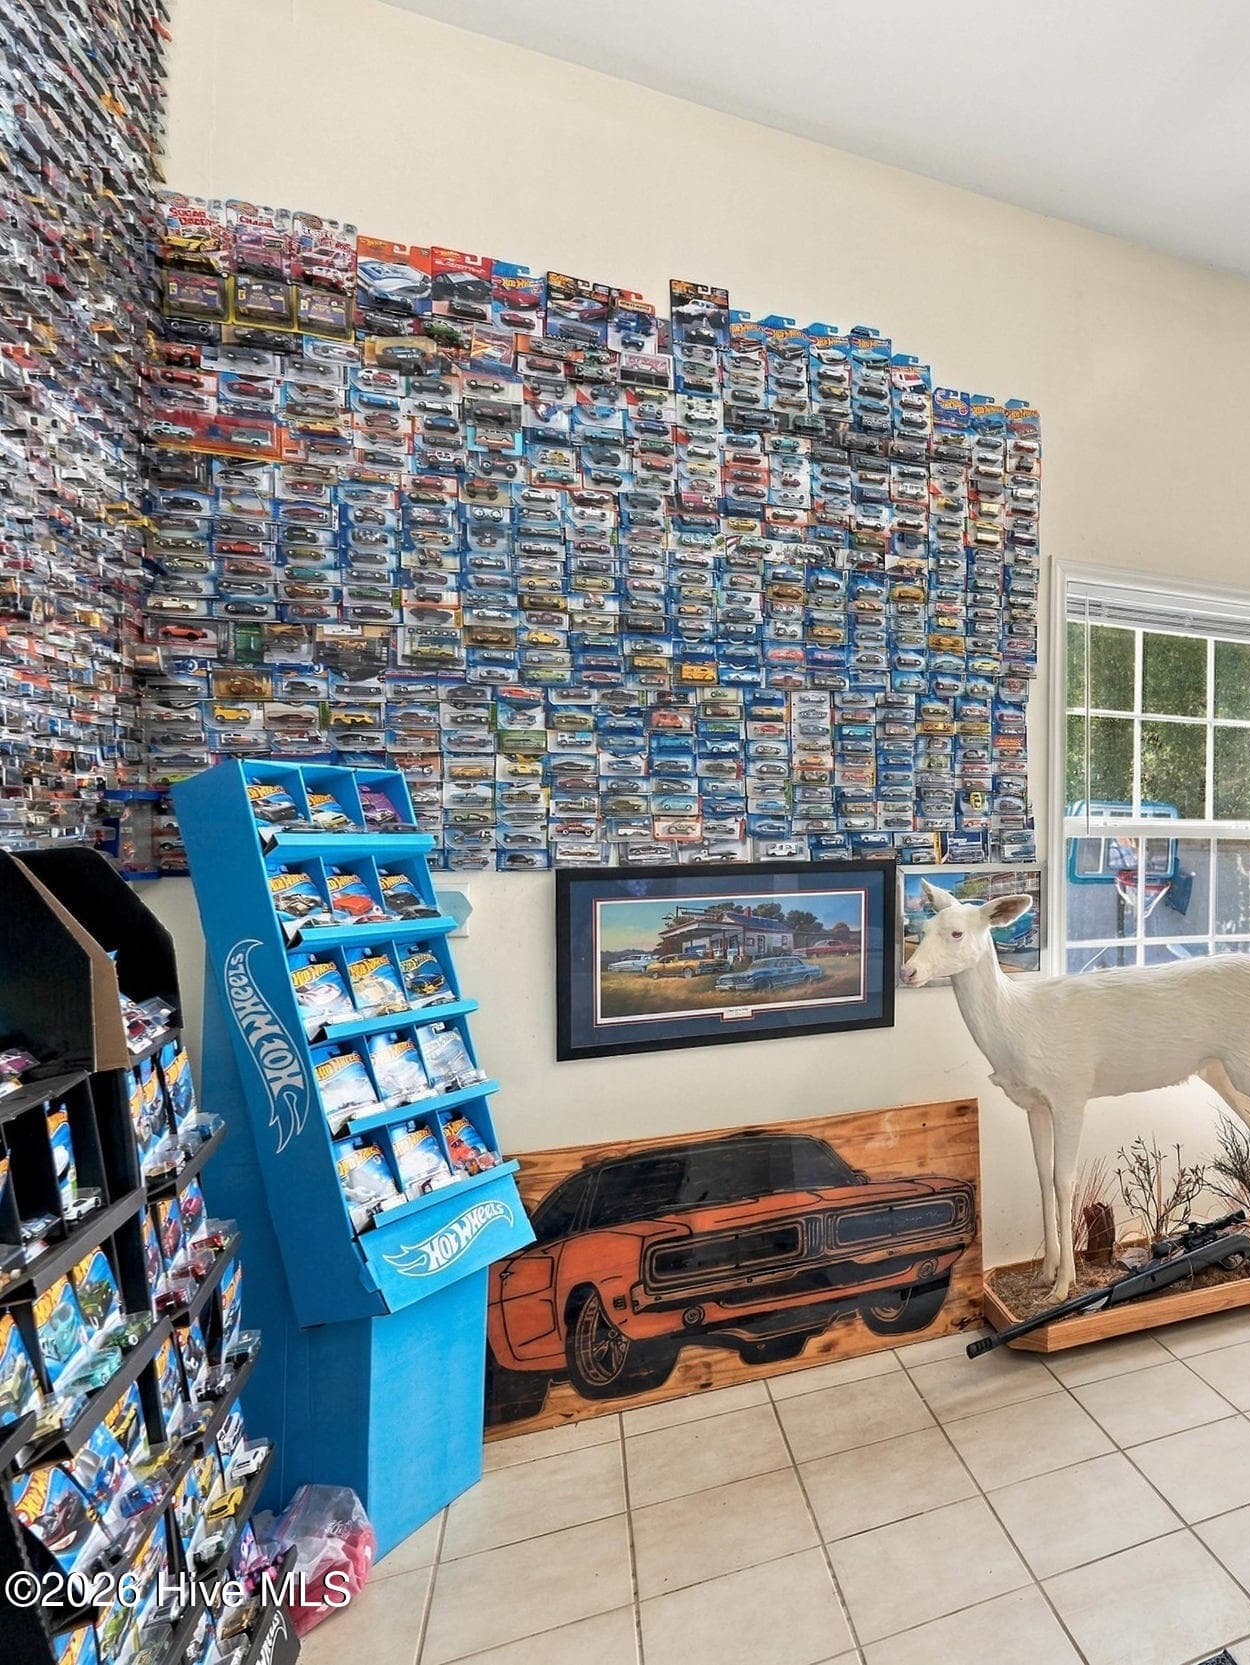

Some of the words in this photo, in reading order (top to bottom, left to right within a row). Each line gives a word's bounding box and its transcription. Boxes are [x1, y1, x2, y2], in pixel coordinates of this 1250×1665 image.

[169, 207, 207, 219] SUGAR
[259, 1038, 304, 1100] HOT
[420, 1233, 460, 1271] HOT
